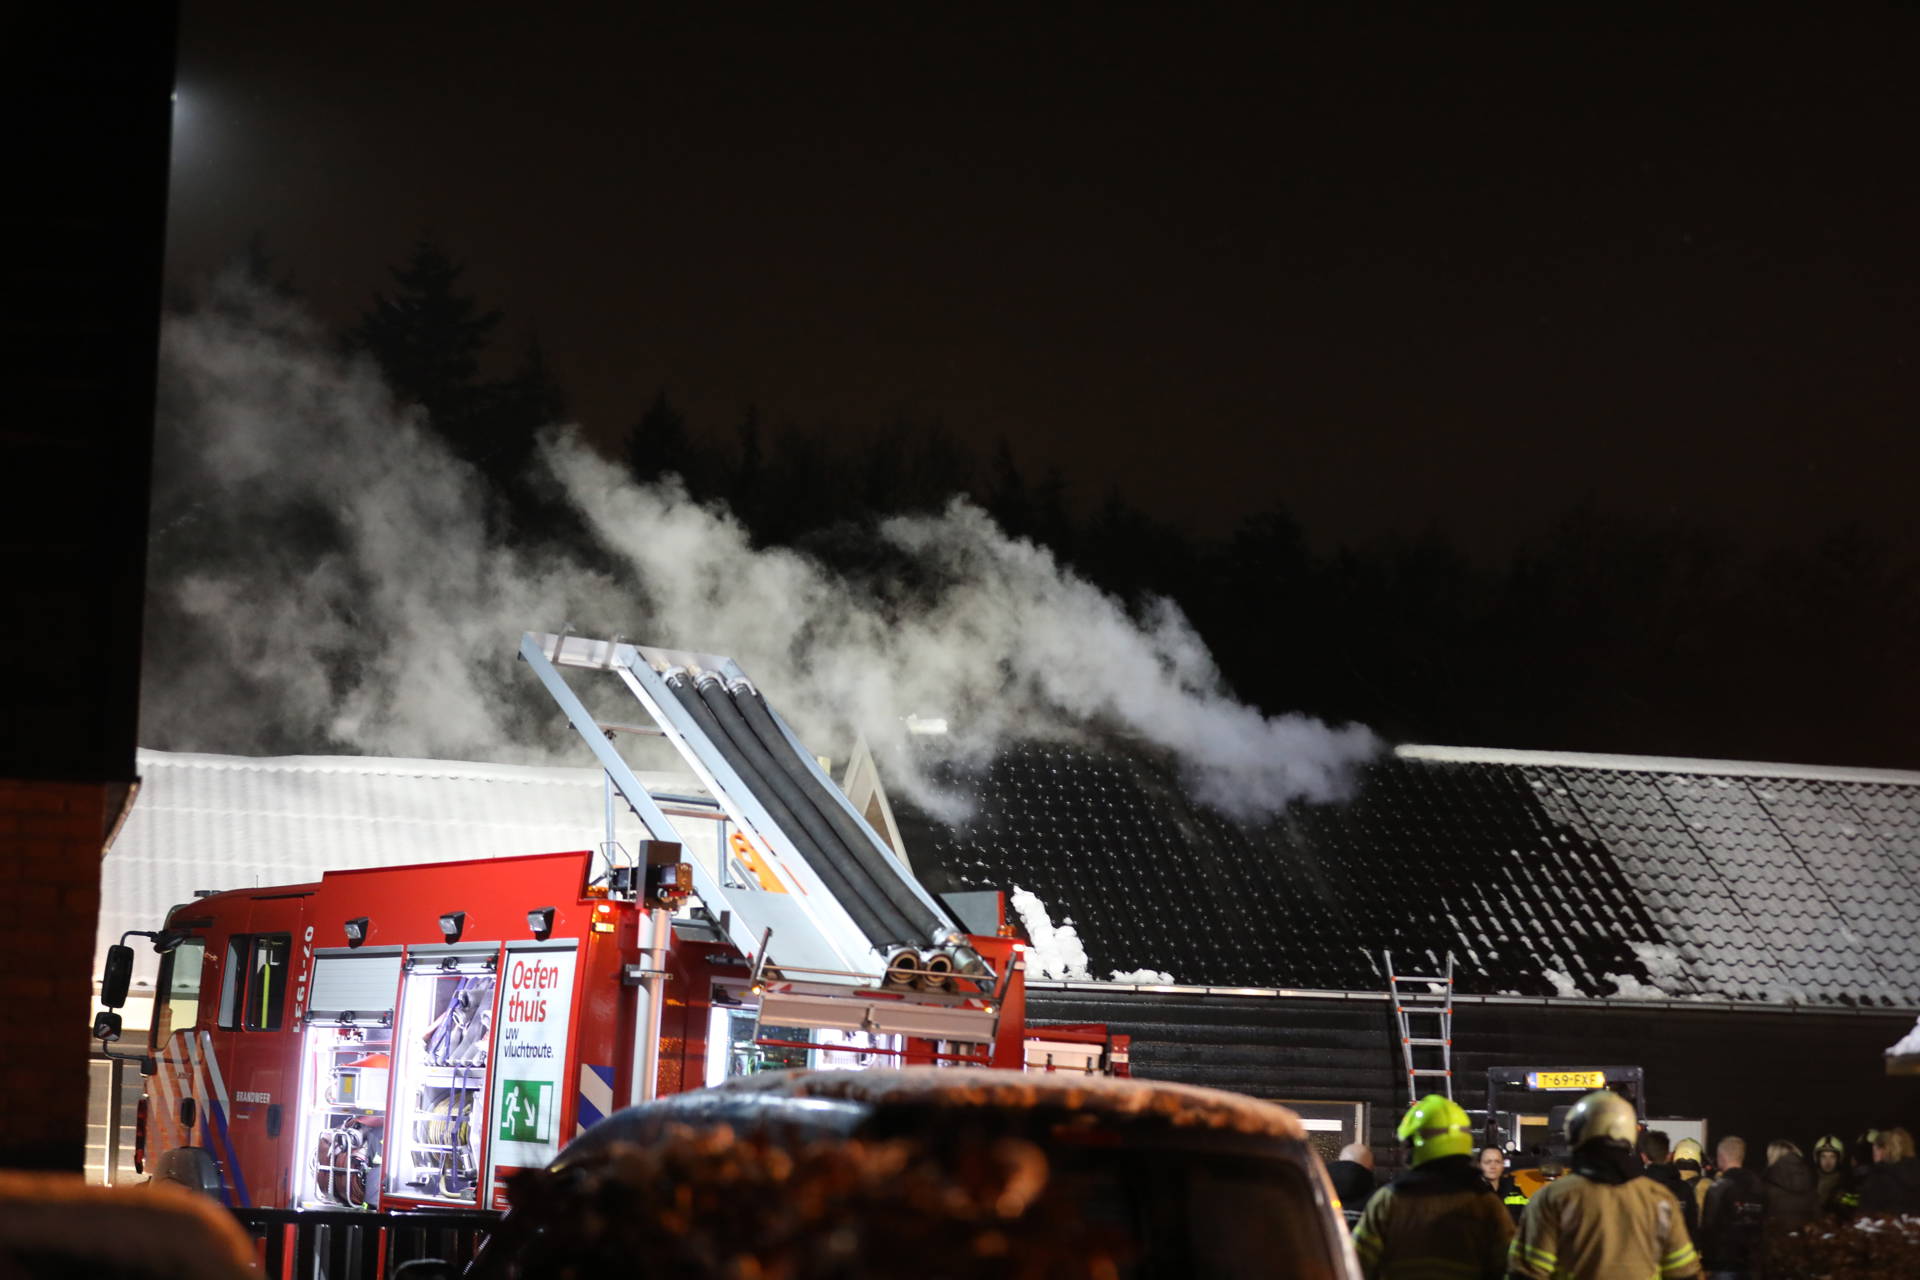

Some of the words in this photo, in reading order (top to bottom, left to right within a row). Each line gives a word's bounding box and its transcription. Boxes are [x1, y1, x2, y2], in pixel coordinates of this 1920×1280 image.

[512, 959, 558, 989] Oefen
[509, 991, 547, 1022] thuis
[505, 1027, 519, 1040] uw
[503, 1040, 554, 1058] vluchtroute.
[236, 1091, 271, 1104] BRANDWEER
